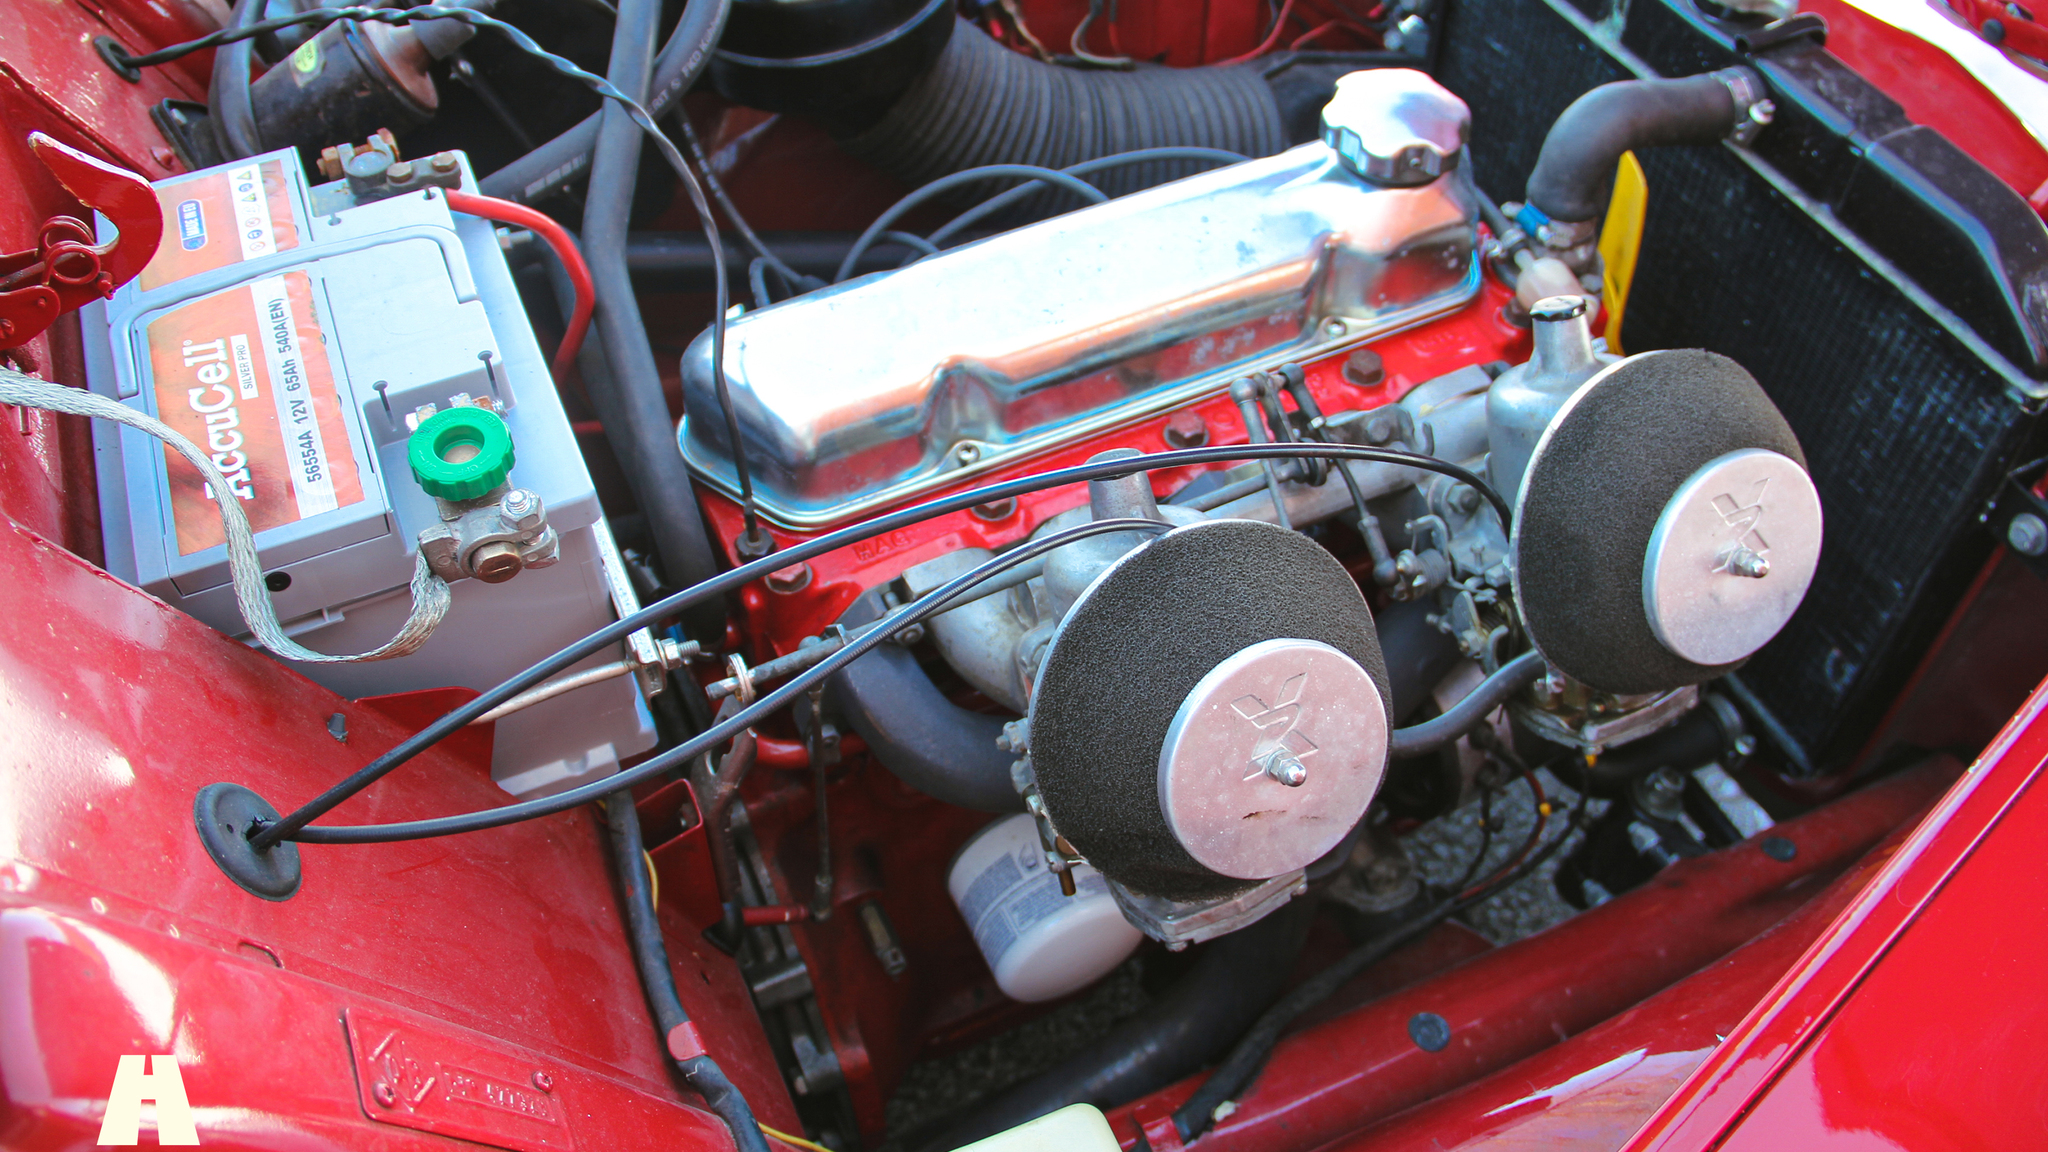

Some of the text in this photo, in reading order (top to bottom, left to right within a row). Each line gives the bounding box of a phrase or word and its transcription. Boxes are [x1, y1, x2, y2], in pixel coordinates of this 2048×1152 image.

[236, 344, 253, 390] SILVER PRO
[268, 298, 322, 483] 56554A 12V 65Ah 540A(EN)
